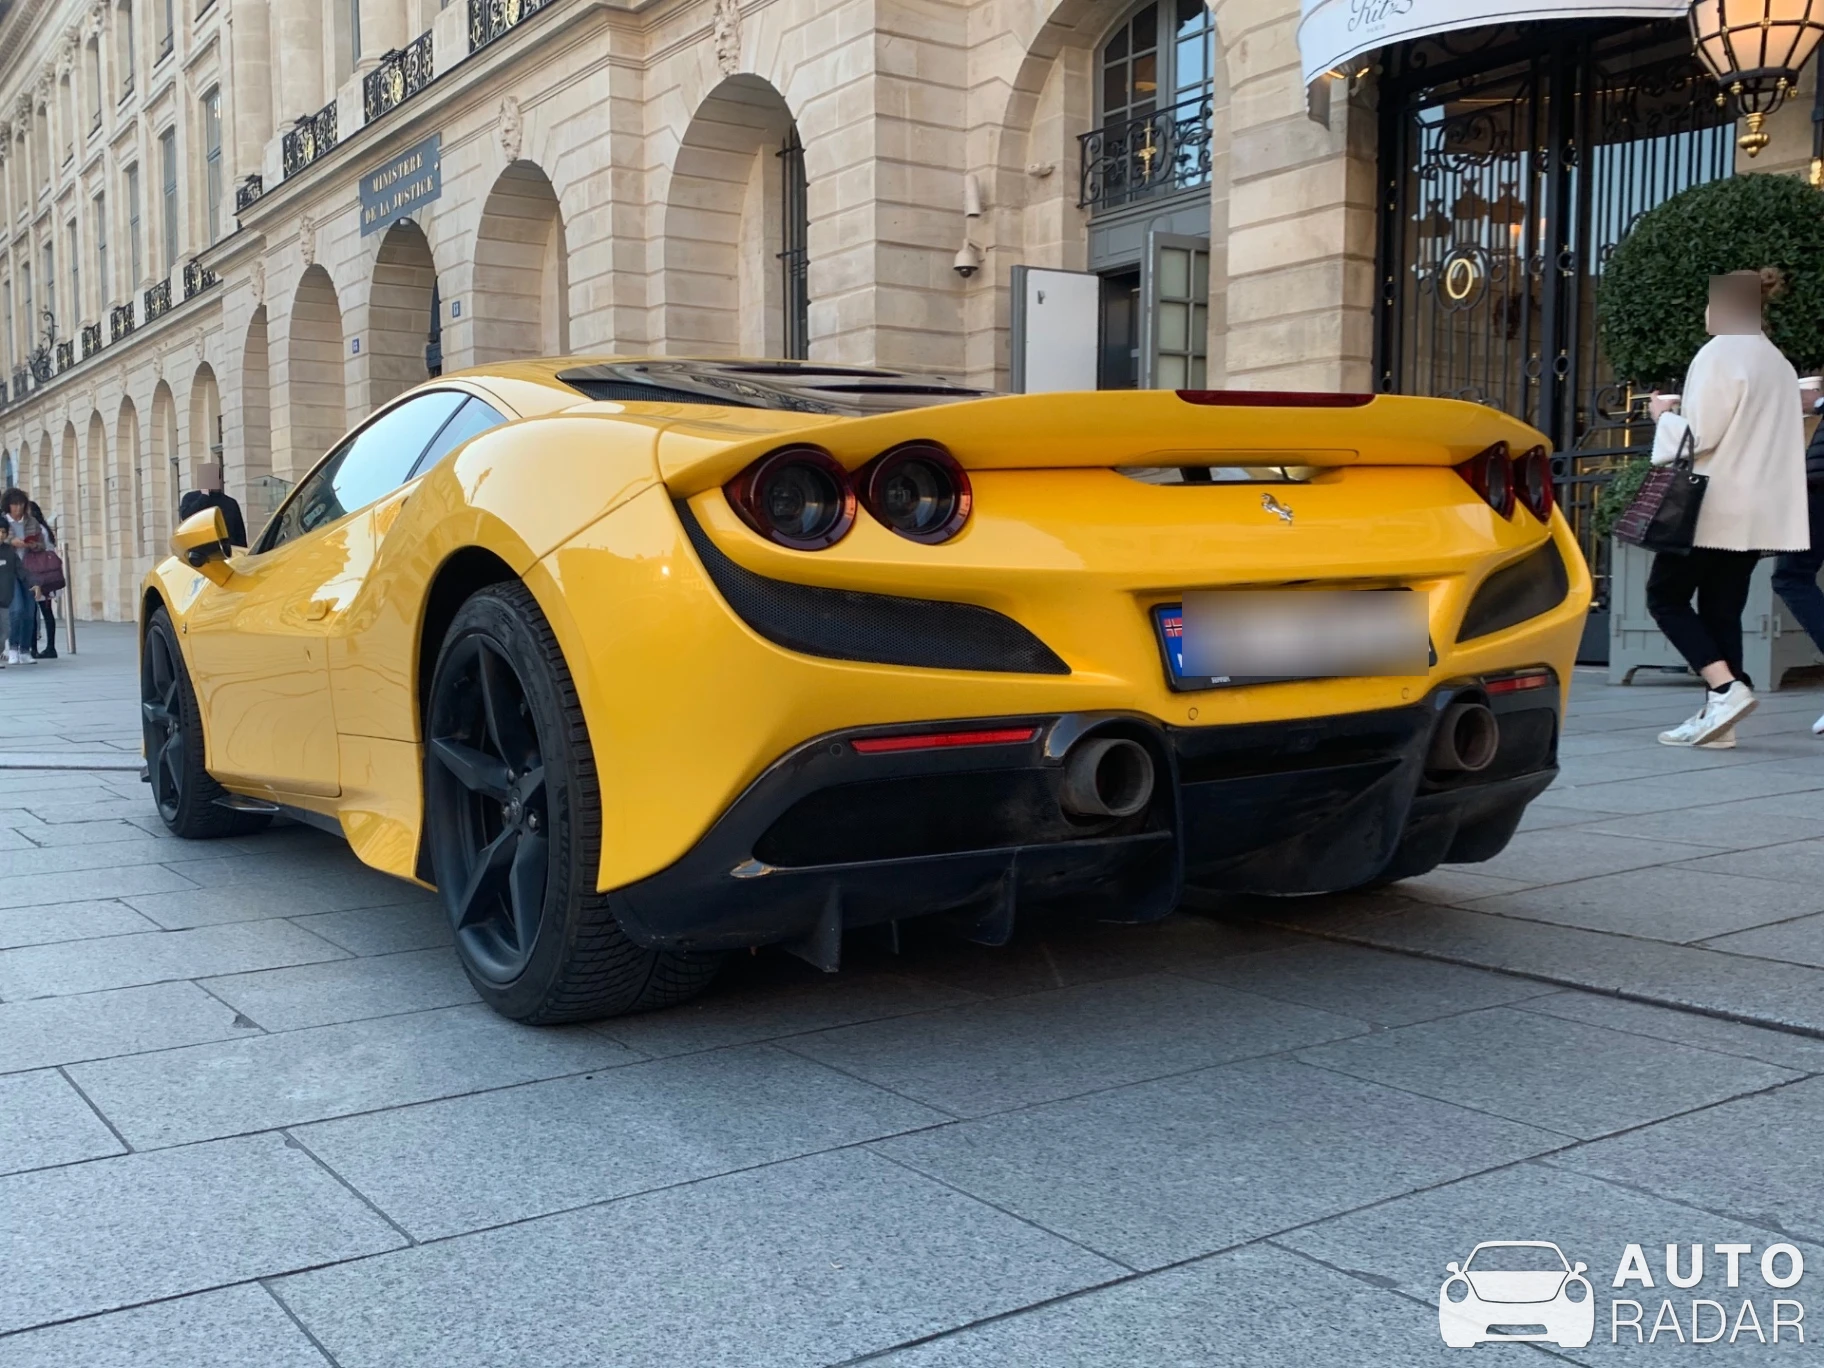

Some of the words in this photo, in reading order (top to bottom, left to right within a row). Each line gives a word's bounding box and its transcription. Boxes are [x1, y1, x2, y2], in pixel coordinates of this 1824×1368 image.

[1348, 0, 1413, 31] Ritz
[365, 205, 377, 225] DE
[380, 200, 391, 217] LA
[393, 175, 434, 210] JUSTICE
